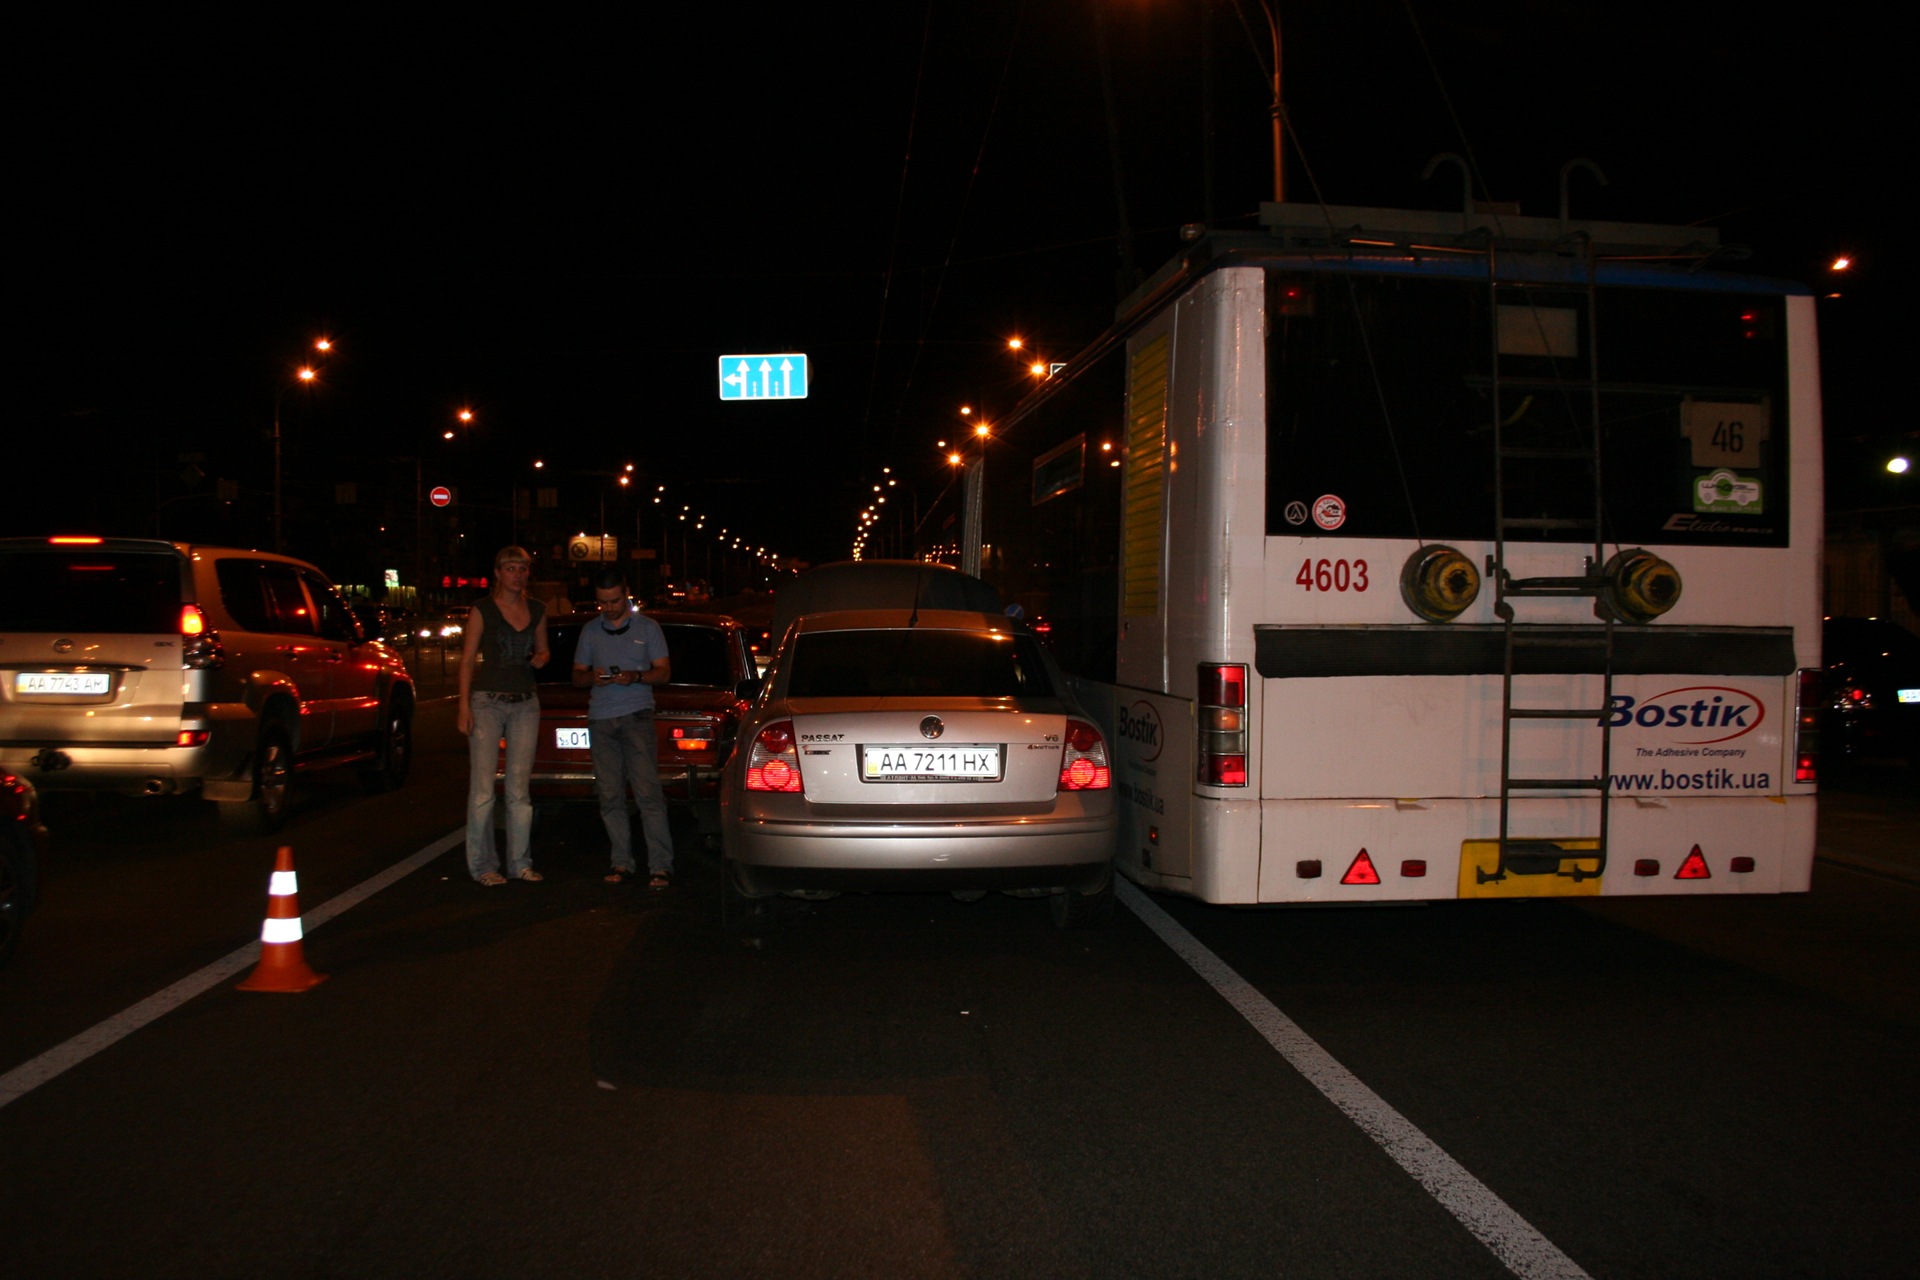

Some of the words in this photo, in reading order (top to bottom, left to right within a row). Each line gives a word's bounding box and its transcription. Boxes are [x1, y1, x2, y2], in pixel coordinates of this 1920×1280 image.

[1711, 421, 1743, 452] 46
[1296, 559, 1368, 592] 4603
[28, 677, 46, 691] AA
[50, 677, 80, 691] 7743
[84, 678, 103, 691] AM
[1597, 696, 1750, 727] Bostik
[1119, 706, 1158, 747] Bostik
[801, 733, 845, 743] PASSAT
[1044, 734, 1059, 742] V6
[881, 753, 907, 771] AA
[914, 753, 956, 771] 7211
[963, 753, 990, 771] HX
[1636, 748, 1653, 757] The
[1656, 747, 1699, 757] Adhesive
[1702, 747, 1746, 759] Company
